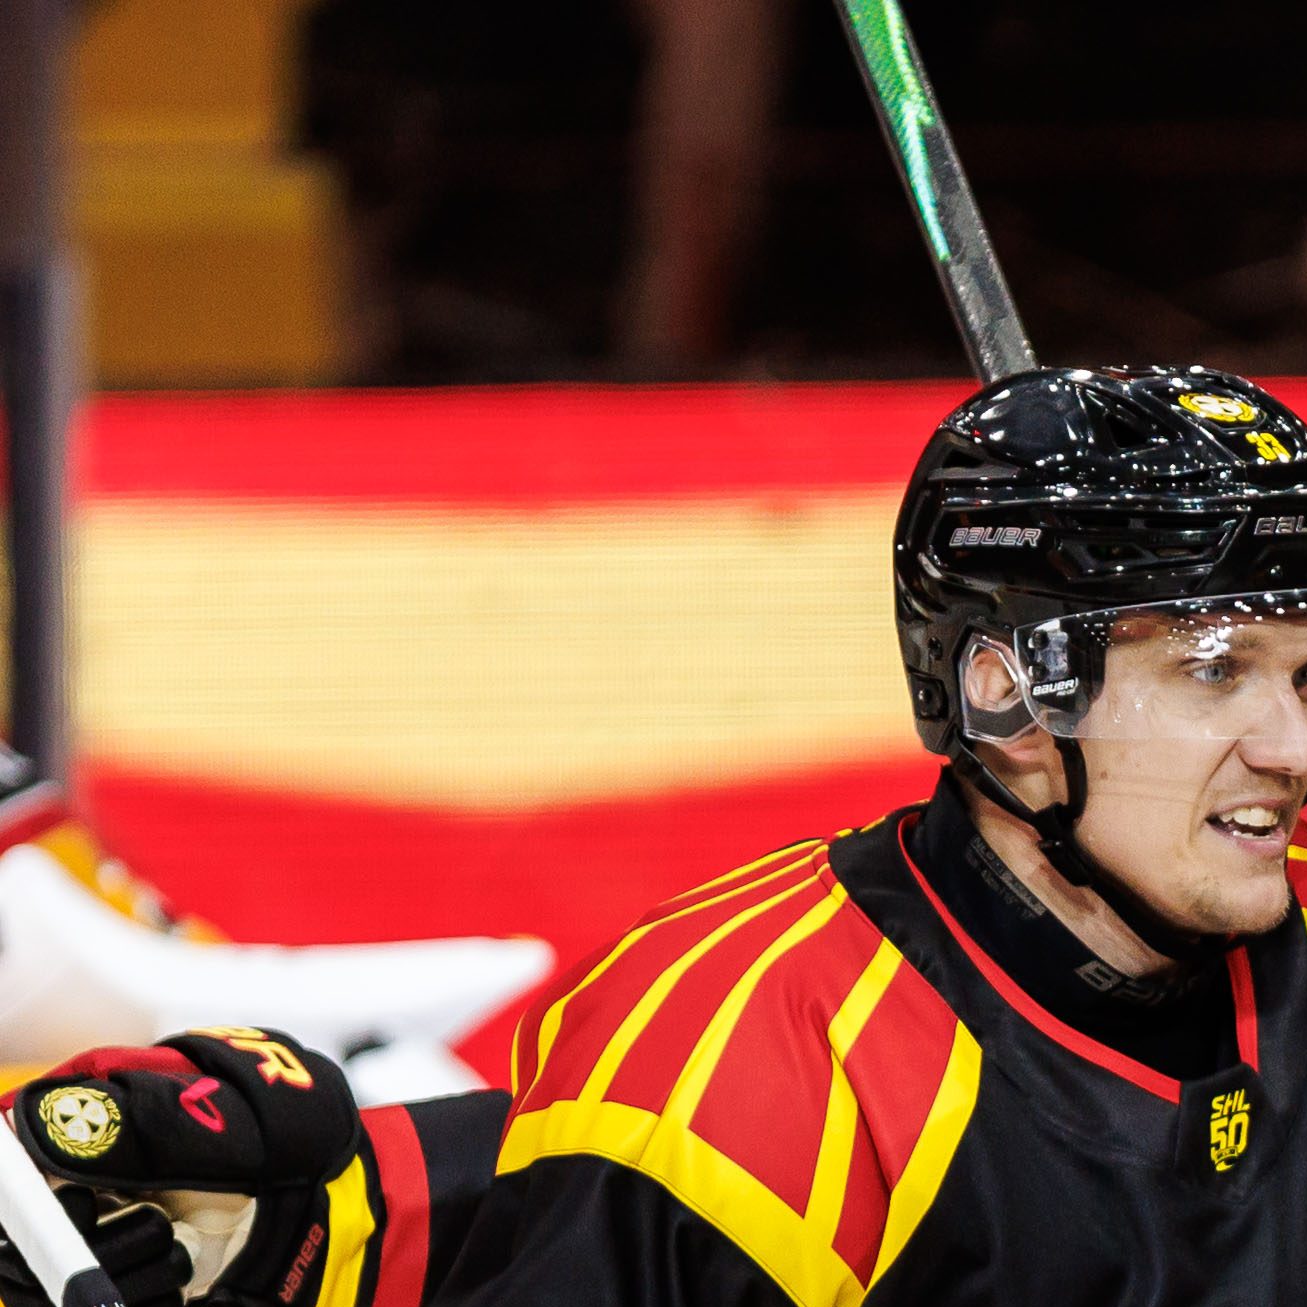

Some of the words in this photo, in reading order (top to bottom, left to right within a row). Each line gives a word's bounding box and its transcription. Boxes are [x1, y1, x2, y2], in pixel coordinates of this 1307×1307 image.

[949, 526, 1042, 547] BAUER
[1209, 1111, 1250, 1166] 50
[276, 1223, 325, 1303] BAUER
